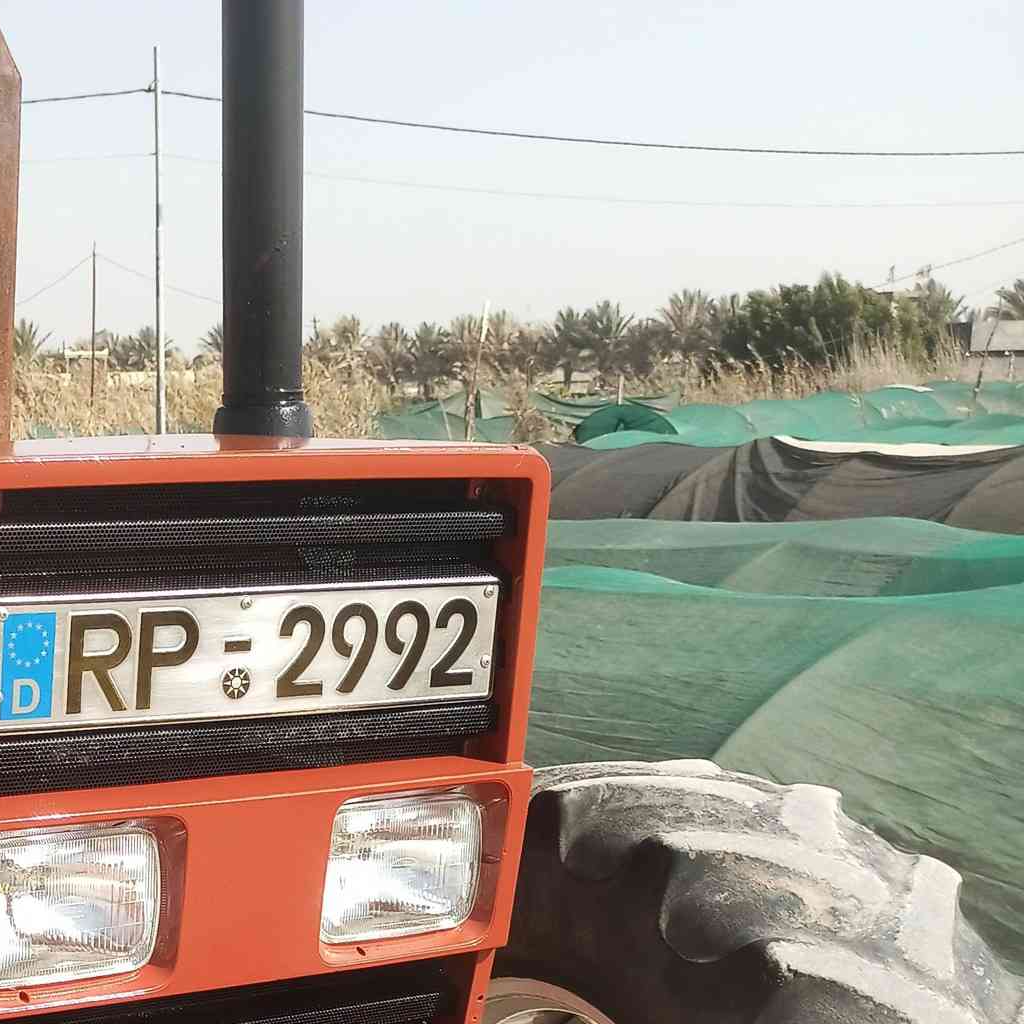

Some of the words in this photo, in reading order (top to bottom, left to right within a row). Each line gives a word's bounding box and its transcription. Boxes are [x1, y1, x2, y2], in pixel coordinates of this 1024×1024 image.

[65, 608, 201, 714] RP
[275, 598, 479, 698] 2992
[10, 679, 41, 715] D
